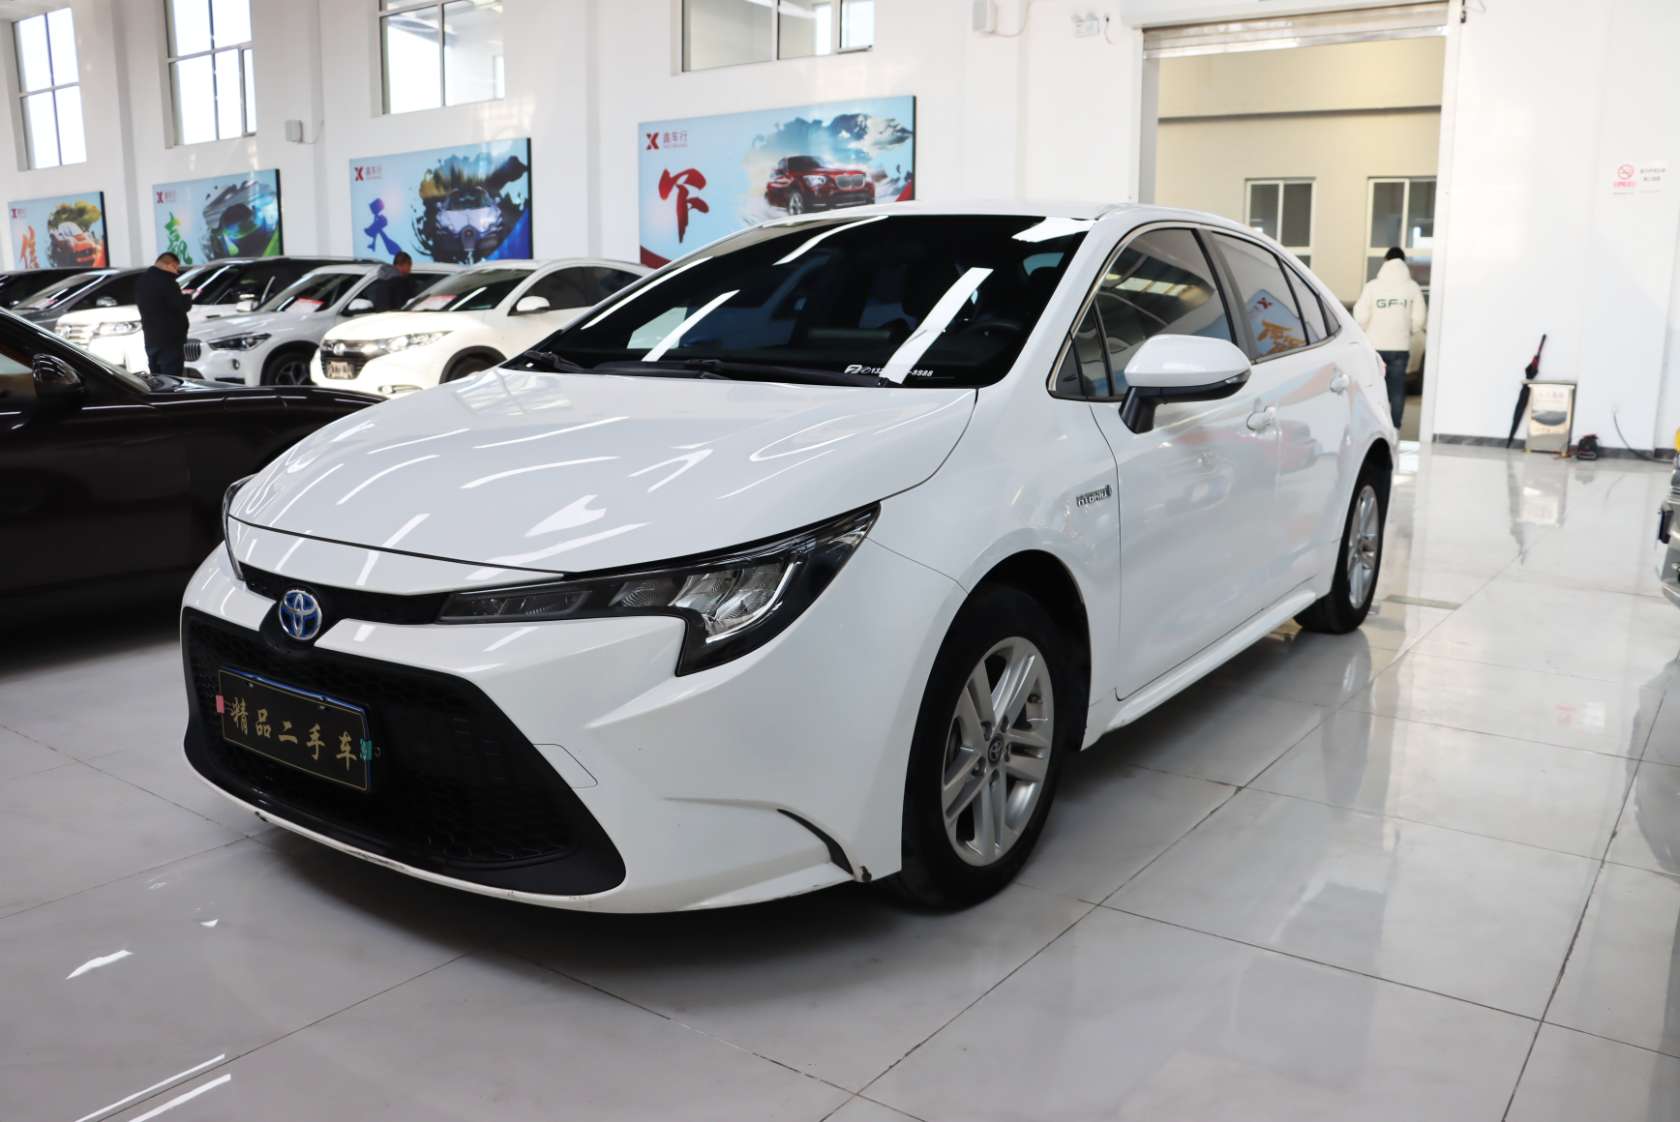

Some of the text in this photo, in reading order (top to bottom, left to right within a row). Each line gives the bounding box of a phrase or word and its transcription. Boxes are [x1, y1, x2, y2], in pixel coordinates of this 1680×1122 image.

[230, 696, 358, 771] 精品二手车
